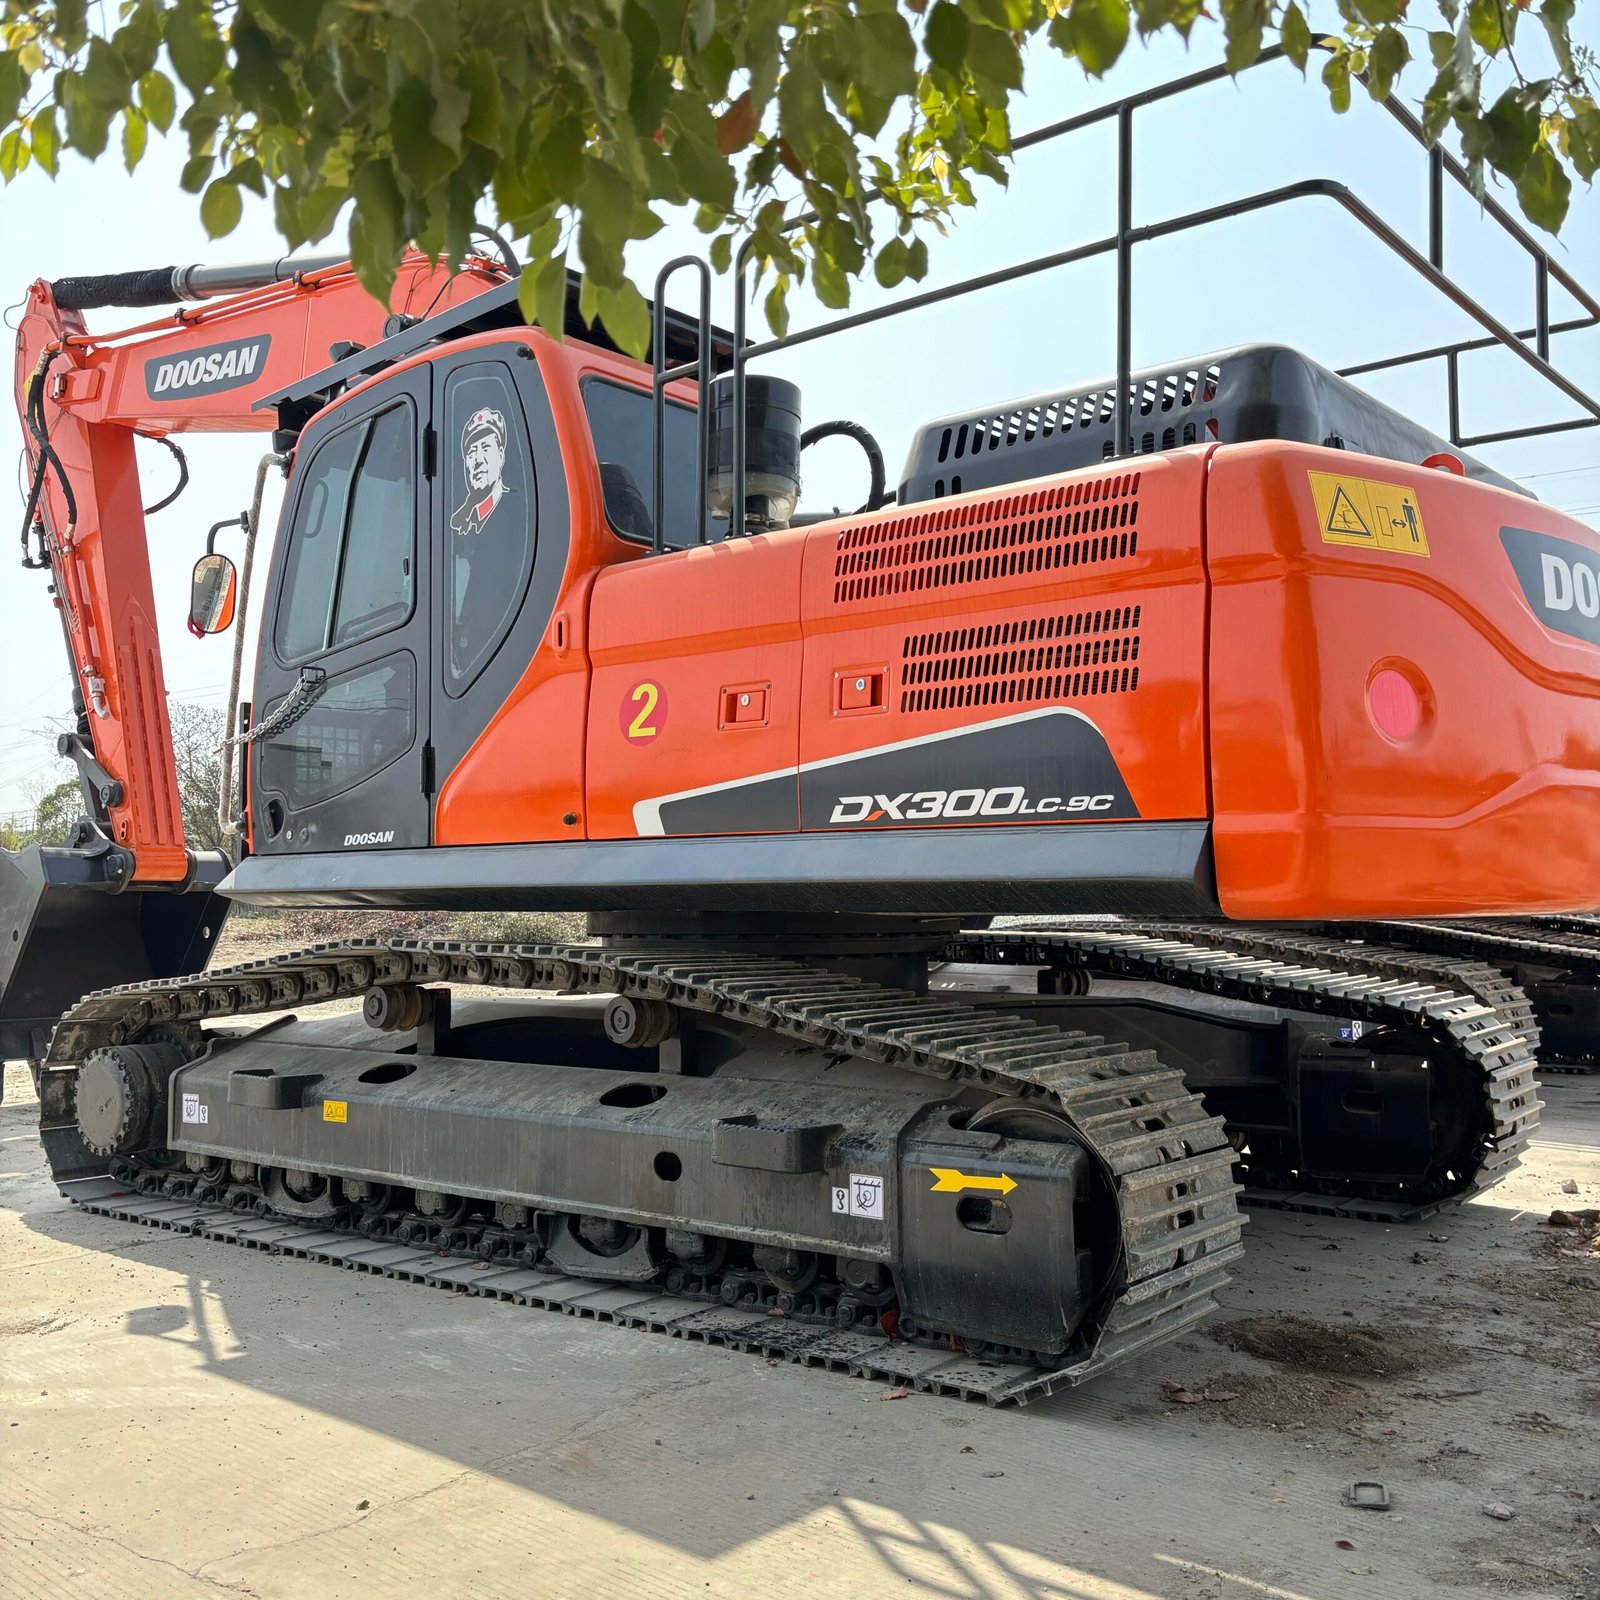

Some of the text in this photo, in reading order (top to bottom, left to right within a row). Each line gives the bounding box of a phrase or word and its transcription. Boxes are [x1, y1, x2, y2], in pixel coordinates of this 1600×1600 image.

[154, 344, 260, 393] DOOSAN
[1540, 552, 1600, 618] DO
[628, 683, 659, 738] 2
[343, 830, 395, 847] DOOSAN
